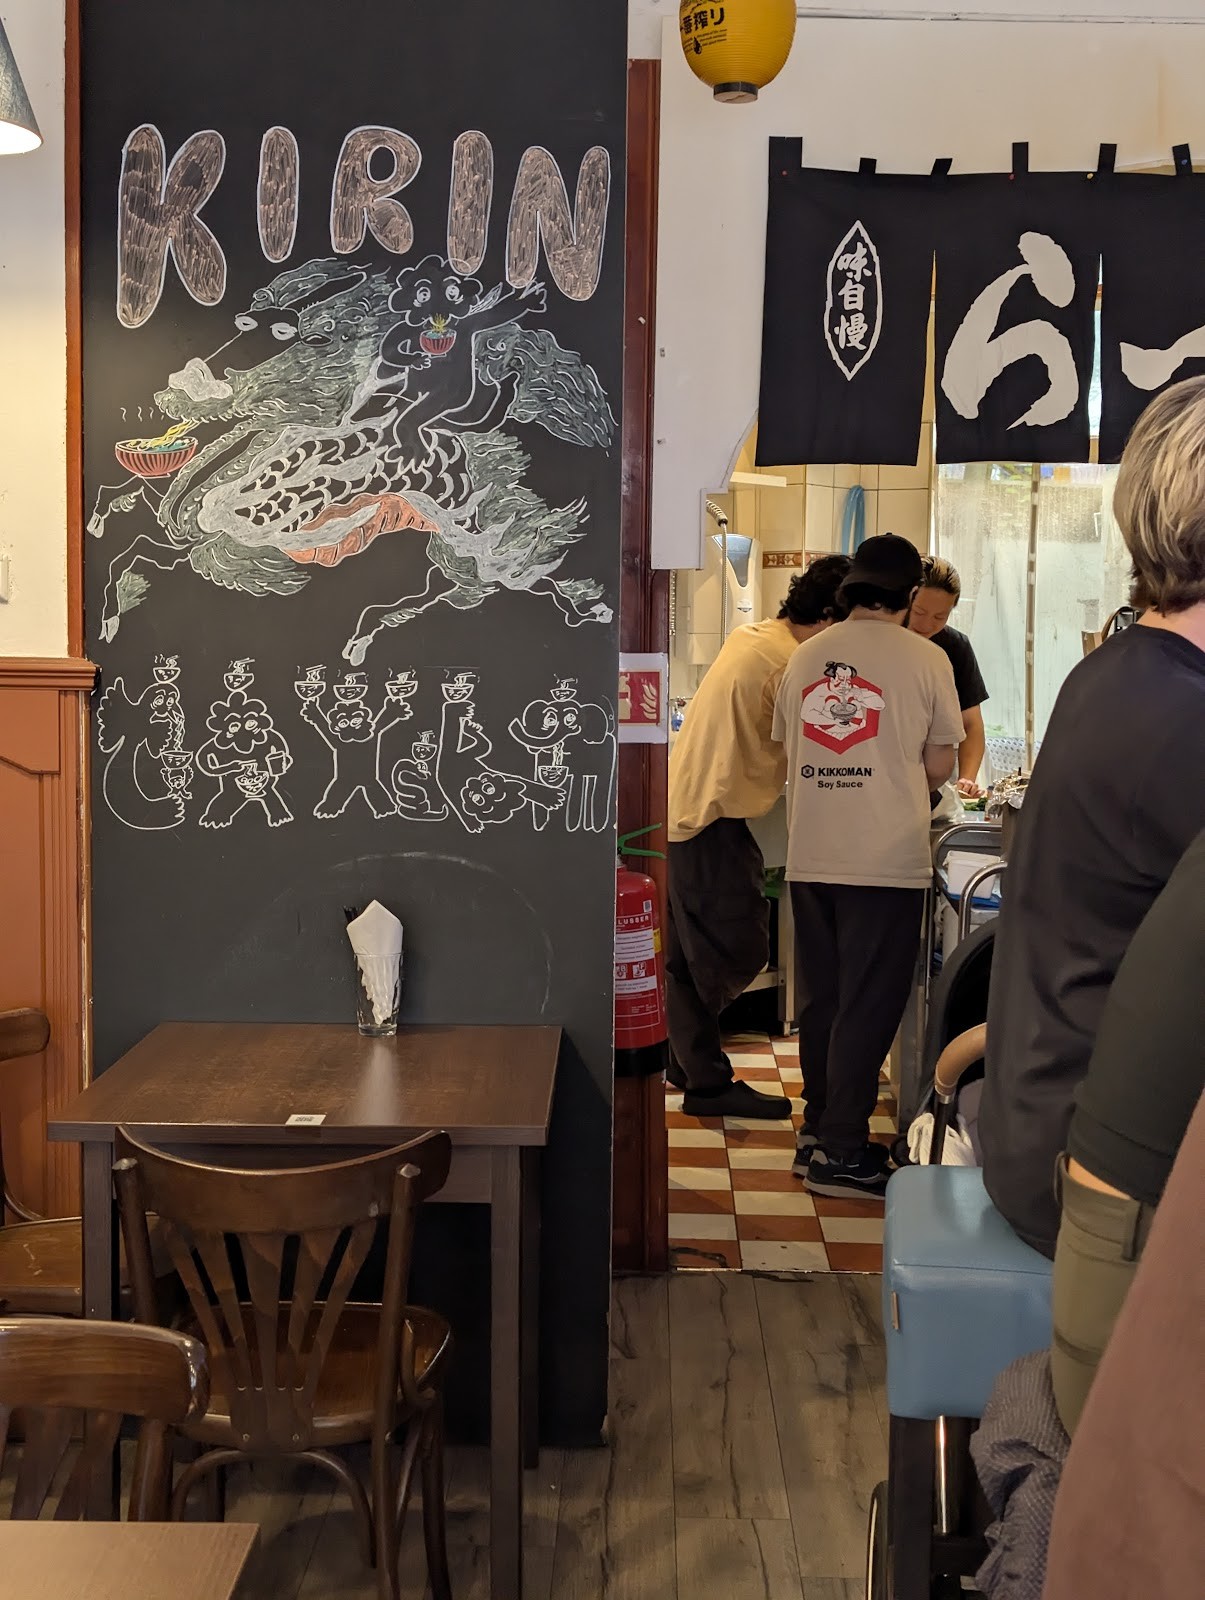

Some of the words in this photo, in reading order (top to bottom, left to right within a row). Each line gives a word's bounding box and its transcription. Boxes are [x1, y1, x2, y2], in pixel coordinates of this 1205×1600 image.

[680, 8, 725, 34] 番搾り
[116, 122, 612, 329] KIRIN
[834, 241, 872, 350] 味自慢
[817, 767, 872, 777] KIKKOMAN
[817, 780, 834, 790] Soy
[836, 780, 864, 788] Sauce
